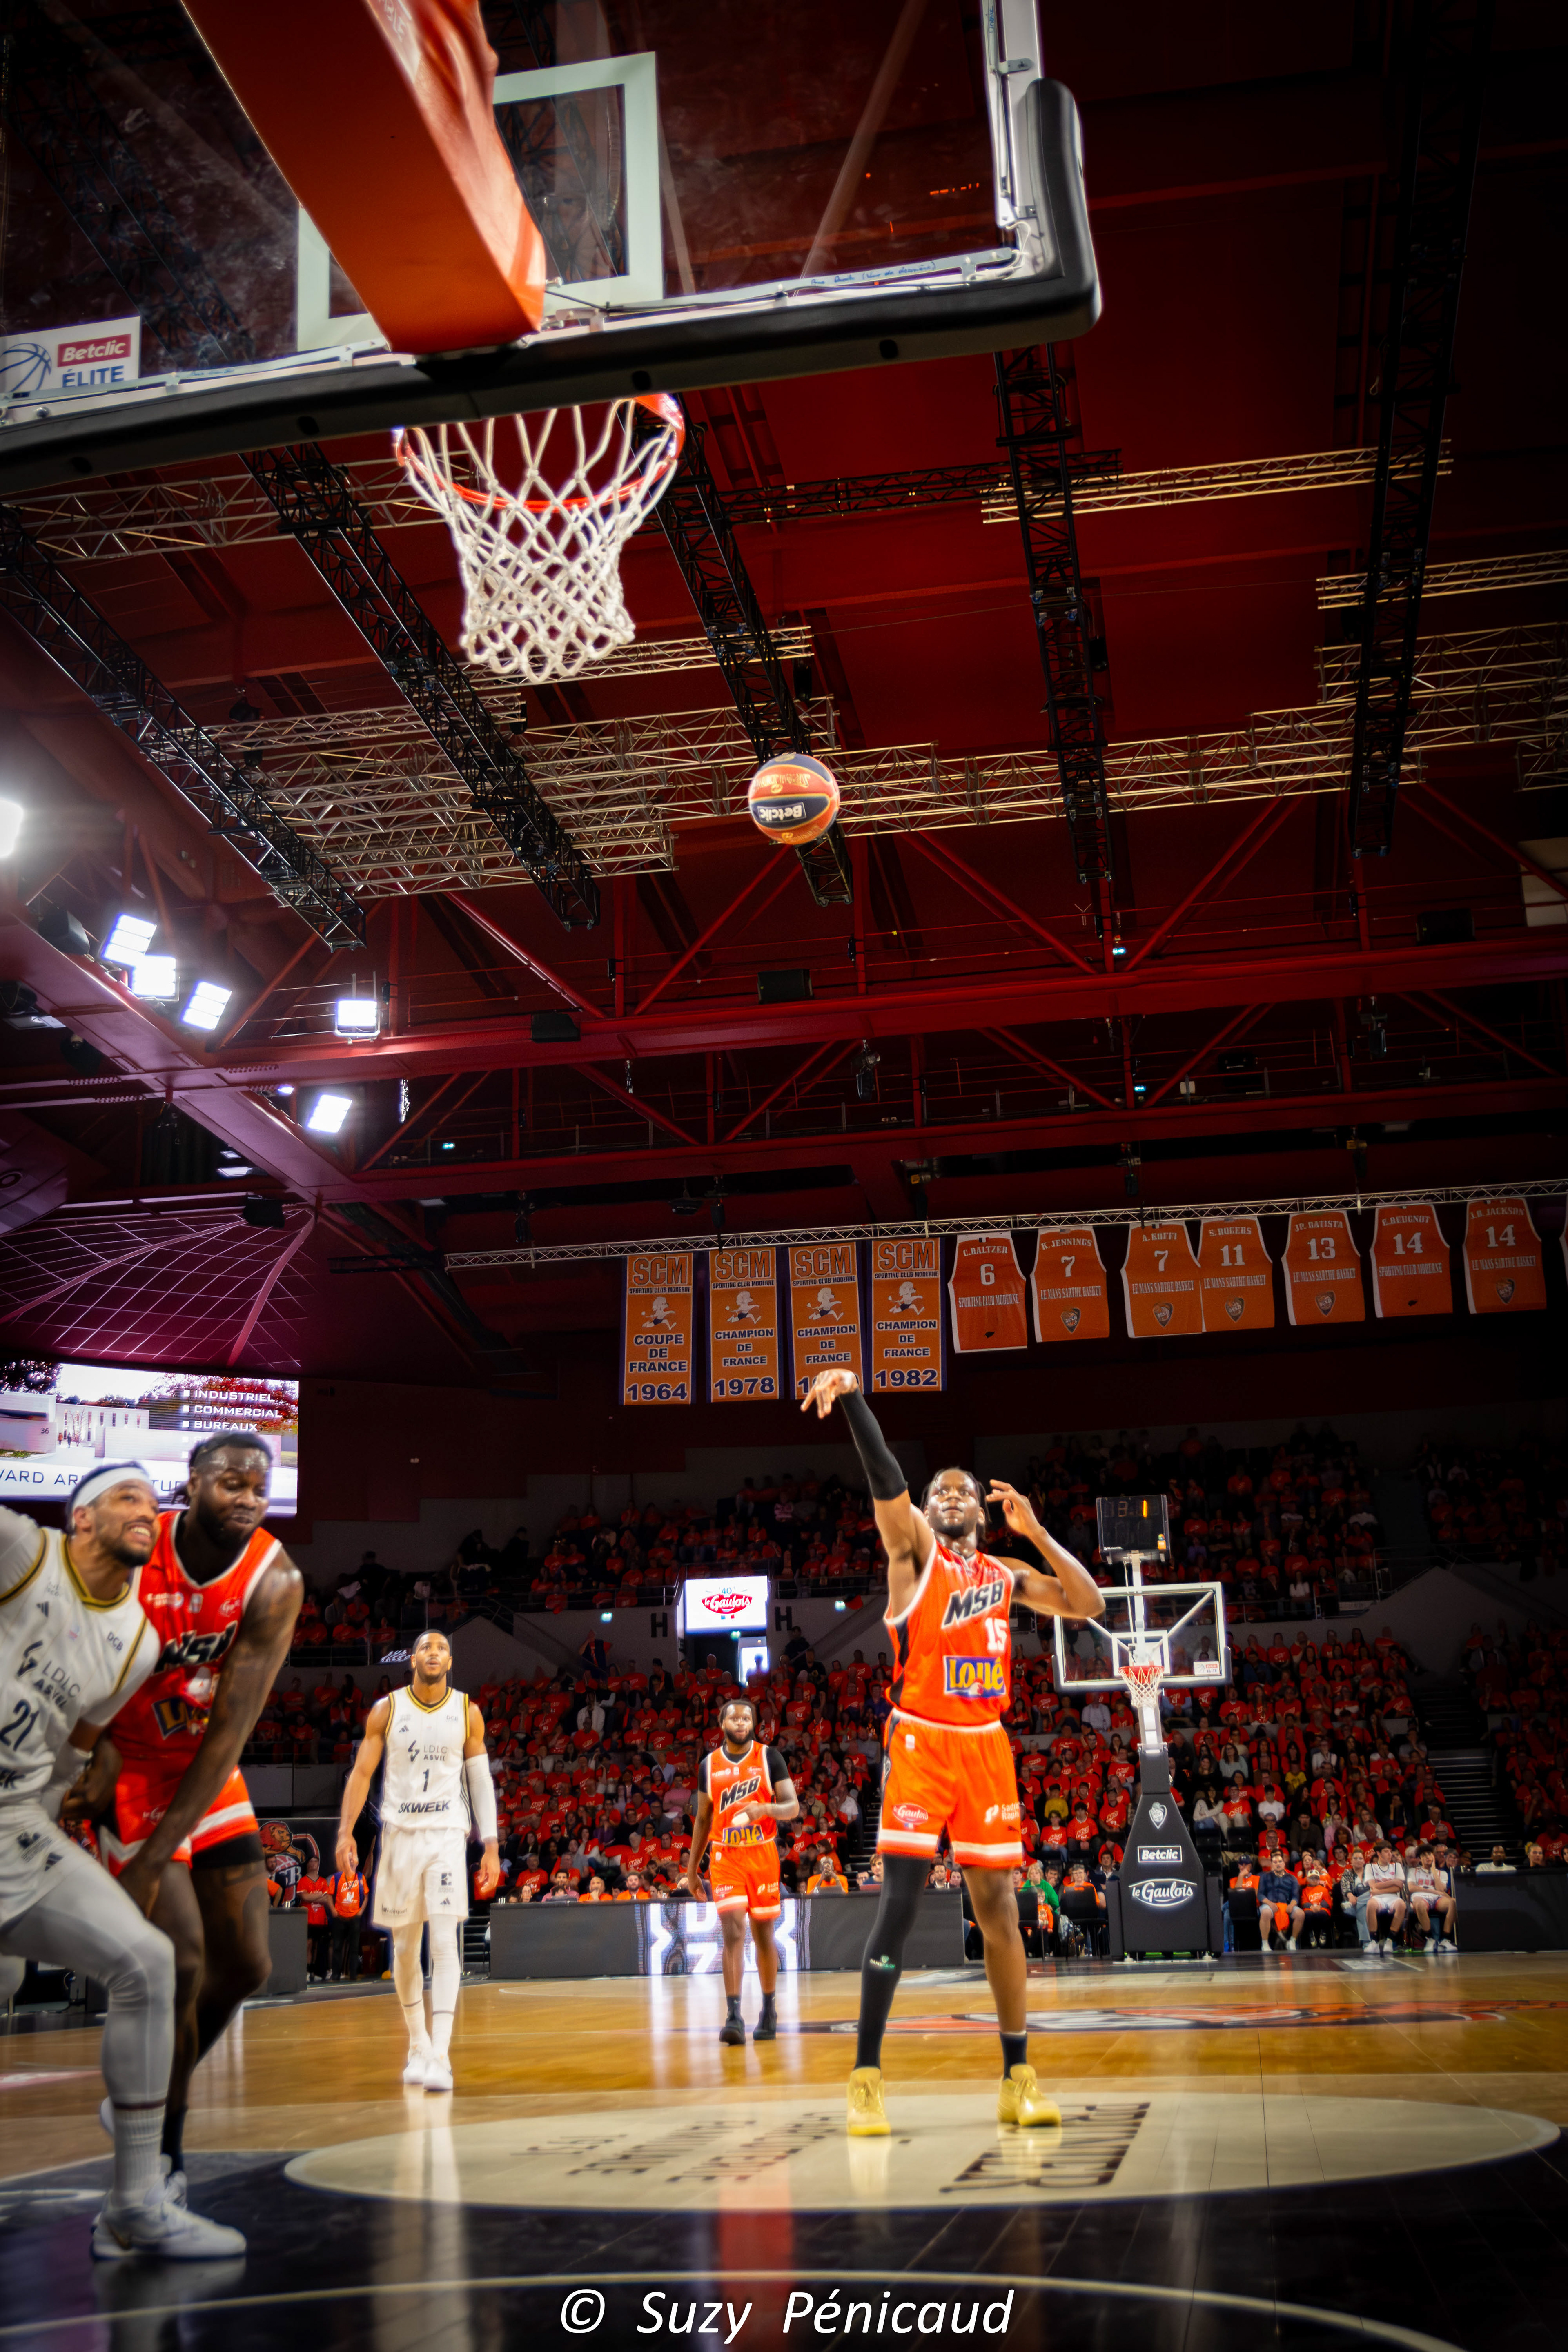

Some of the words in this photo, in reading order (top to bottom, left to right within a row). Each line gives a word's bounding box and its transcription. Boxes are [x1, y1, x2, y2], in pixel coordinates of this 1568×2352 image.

[62, 340, 126, 362] Betclic
[62, 365, 124, 388] ÉLITE
[760, 805, 802, 821] Betclic
[1308, 1221, 1343, 1229] BATISTA
[1051, 1238, 1092, 1247] JENNINGS
[1393, 1232, 1423, 1255] 14
[1486, 1224, 1516, 1248] 14
[878, 1241, 935, 1270] SCM
[1220, 1244, 1245, 1266] 11
[1307, 1238, 1335, 1260] 13
[633, 1256, 688, 1285] SCM
[716, 1250, 771, 1280] SCM
[795, 1246, 851, 1277] SCM
[1061, 1256, 1075, 1277] 7
[1154, 1250, 1168, 1272] 7
[980, 1263, 995, 1285] 6
[715, 1329, 774, 1340] CHAMPION
[797, 1324, 856, 1337] CHAMPION
[877, 1320, 937, 1330] CHAMPION
[634, 1334, 683, 1345] COUPE
[737, 1343, 752, 1352] DE
[820, 1340, 835, 1348] DE
[900, 1334, 914, 1343] DE
[648, 1348, 668, 1359] DE
[722, 1356, 767, 1367] FRANCE
[806, 1352, 851, 1364] FRANCE
[884, 1348, 930, 1358] FRANCE
[629, 1361, 687, 1372] FRANCE
[715, 1376, 775, 1396] 1978
[875, 1369, 937, 1387] 1982
[195, 1390, 275, 1402] INDUSTRIEL
[627, 1383, 687, 1401] 1964
[194, 1405, 283, 1417] COMMERCIAL
[194, 1421, 258, 1431] BUREAUX
[704, 1597, 710, 1606] le
[710, 1595, 750, 1611] Gaulois
[941, 1579, 1004, 1628] MSB
[650, 1612, 668, 1637] H
[775, 1606, 792, 1631] H
[108, 1631, 123, 1650] DCB
[985, 1617, 1007, 1651] 15
[42, 1660, 80, 1697] LDLC
[950, 1656, 1004, 1690] Loué
[33, 1679, 67, 1711] ASVEL
[0, 1699, 39, 1751] 21
[424, 1745, 448, 1753] LDLC
[423, 1769, 429, 1791] 1
[719, 1776, 761, 1814] MSB
[398, 1800, 452, 1813] SKWEEK
[1142, 1849, 1178, 1860] Betclic
[1132, 1886, 1140, 1897] le
[1142, 1881, 1193, 1903] Gaulois
